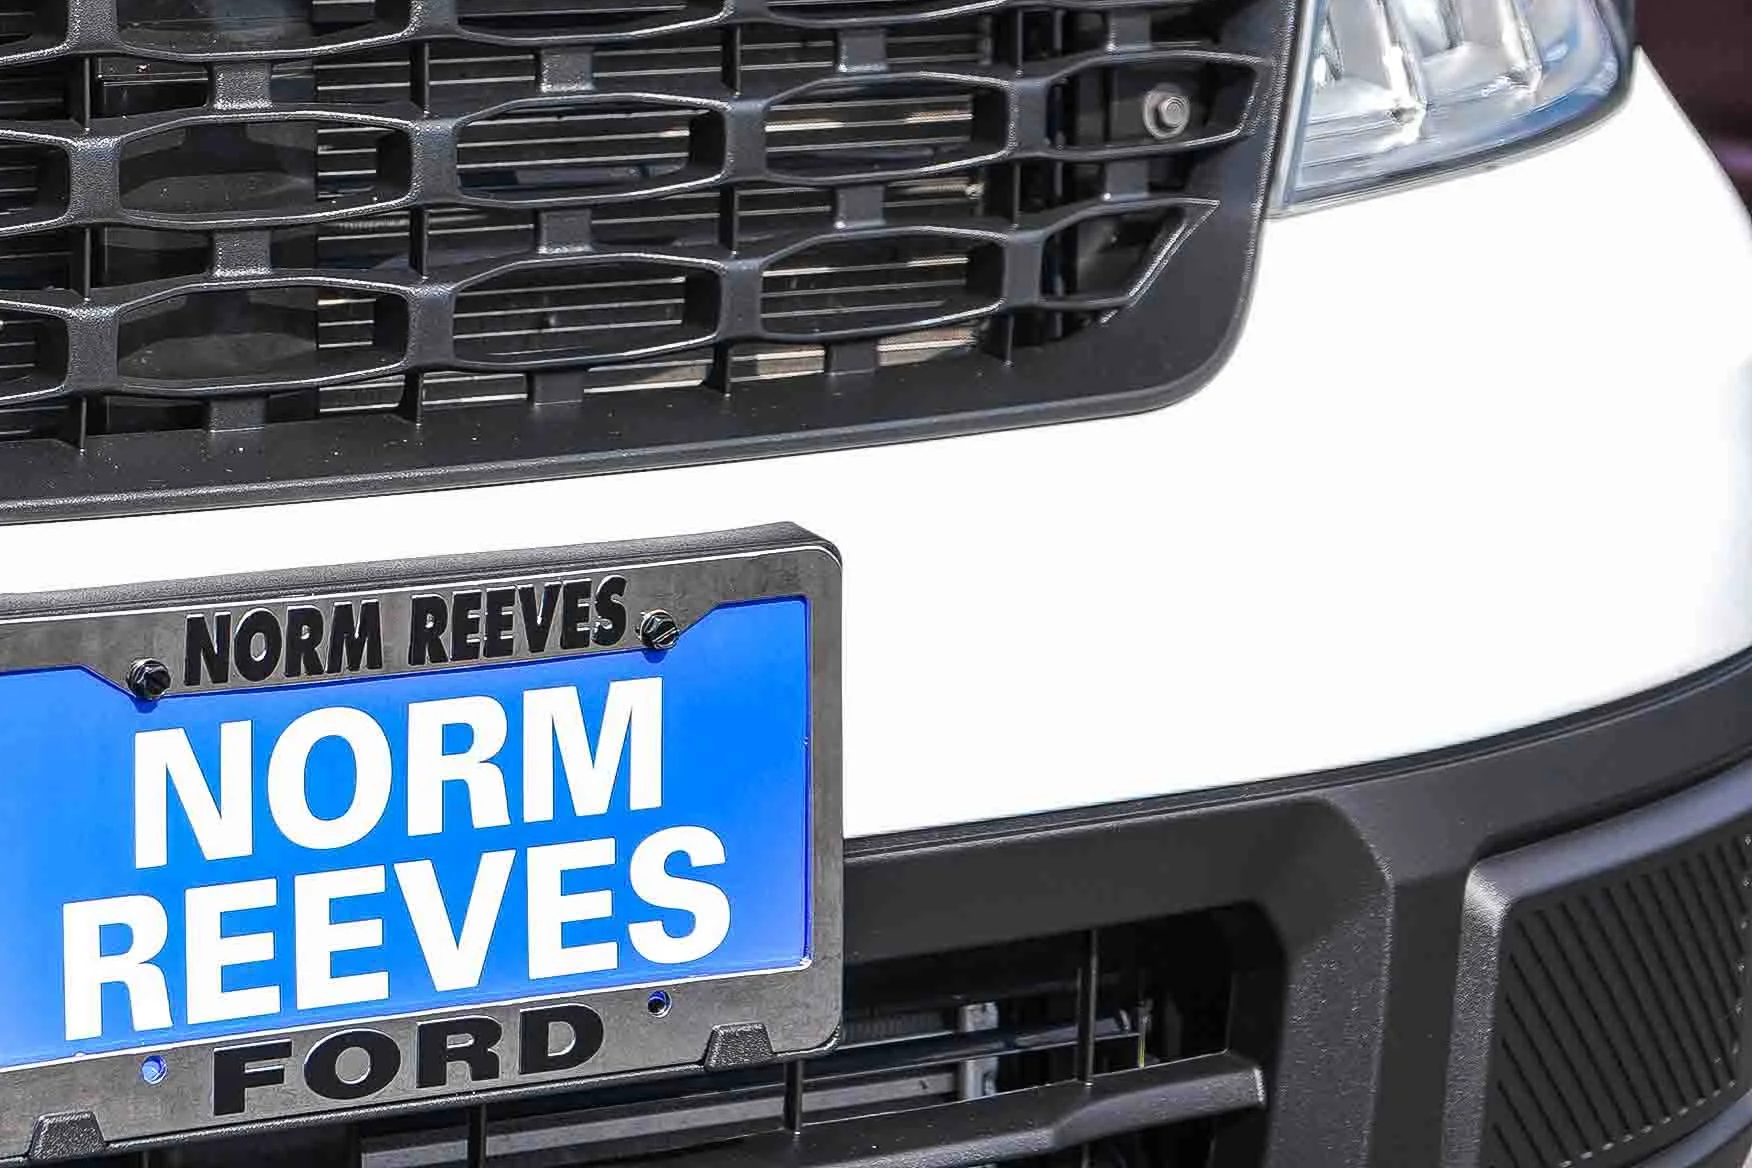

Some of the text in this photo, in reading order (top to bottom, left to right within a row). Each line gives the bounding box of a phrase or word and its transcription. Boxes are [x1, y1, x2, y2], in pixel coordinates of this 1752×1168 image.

[184, 574, 629, 687] NORM REEVES
[133, 676, 664, 869] NORM
[63, 826, 732, 1042] REEVES
[212, 1003, 605, 1117] FORD
